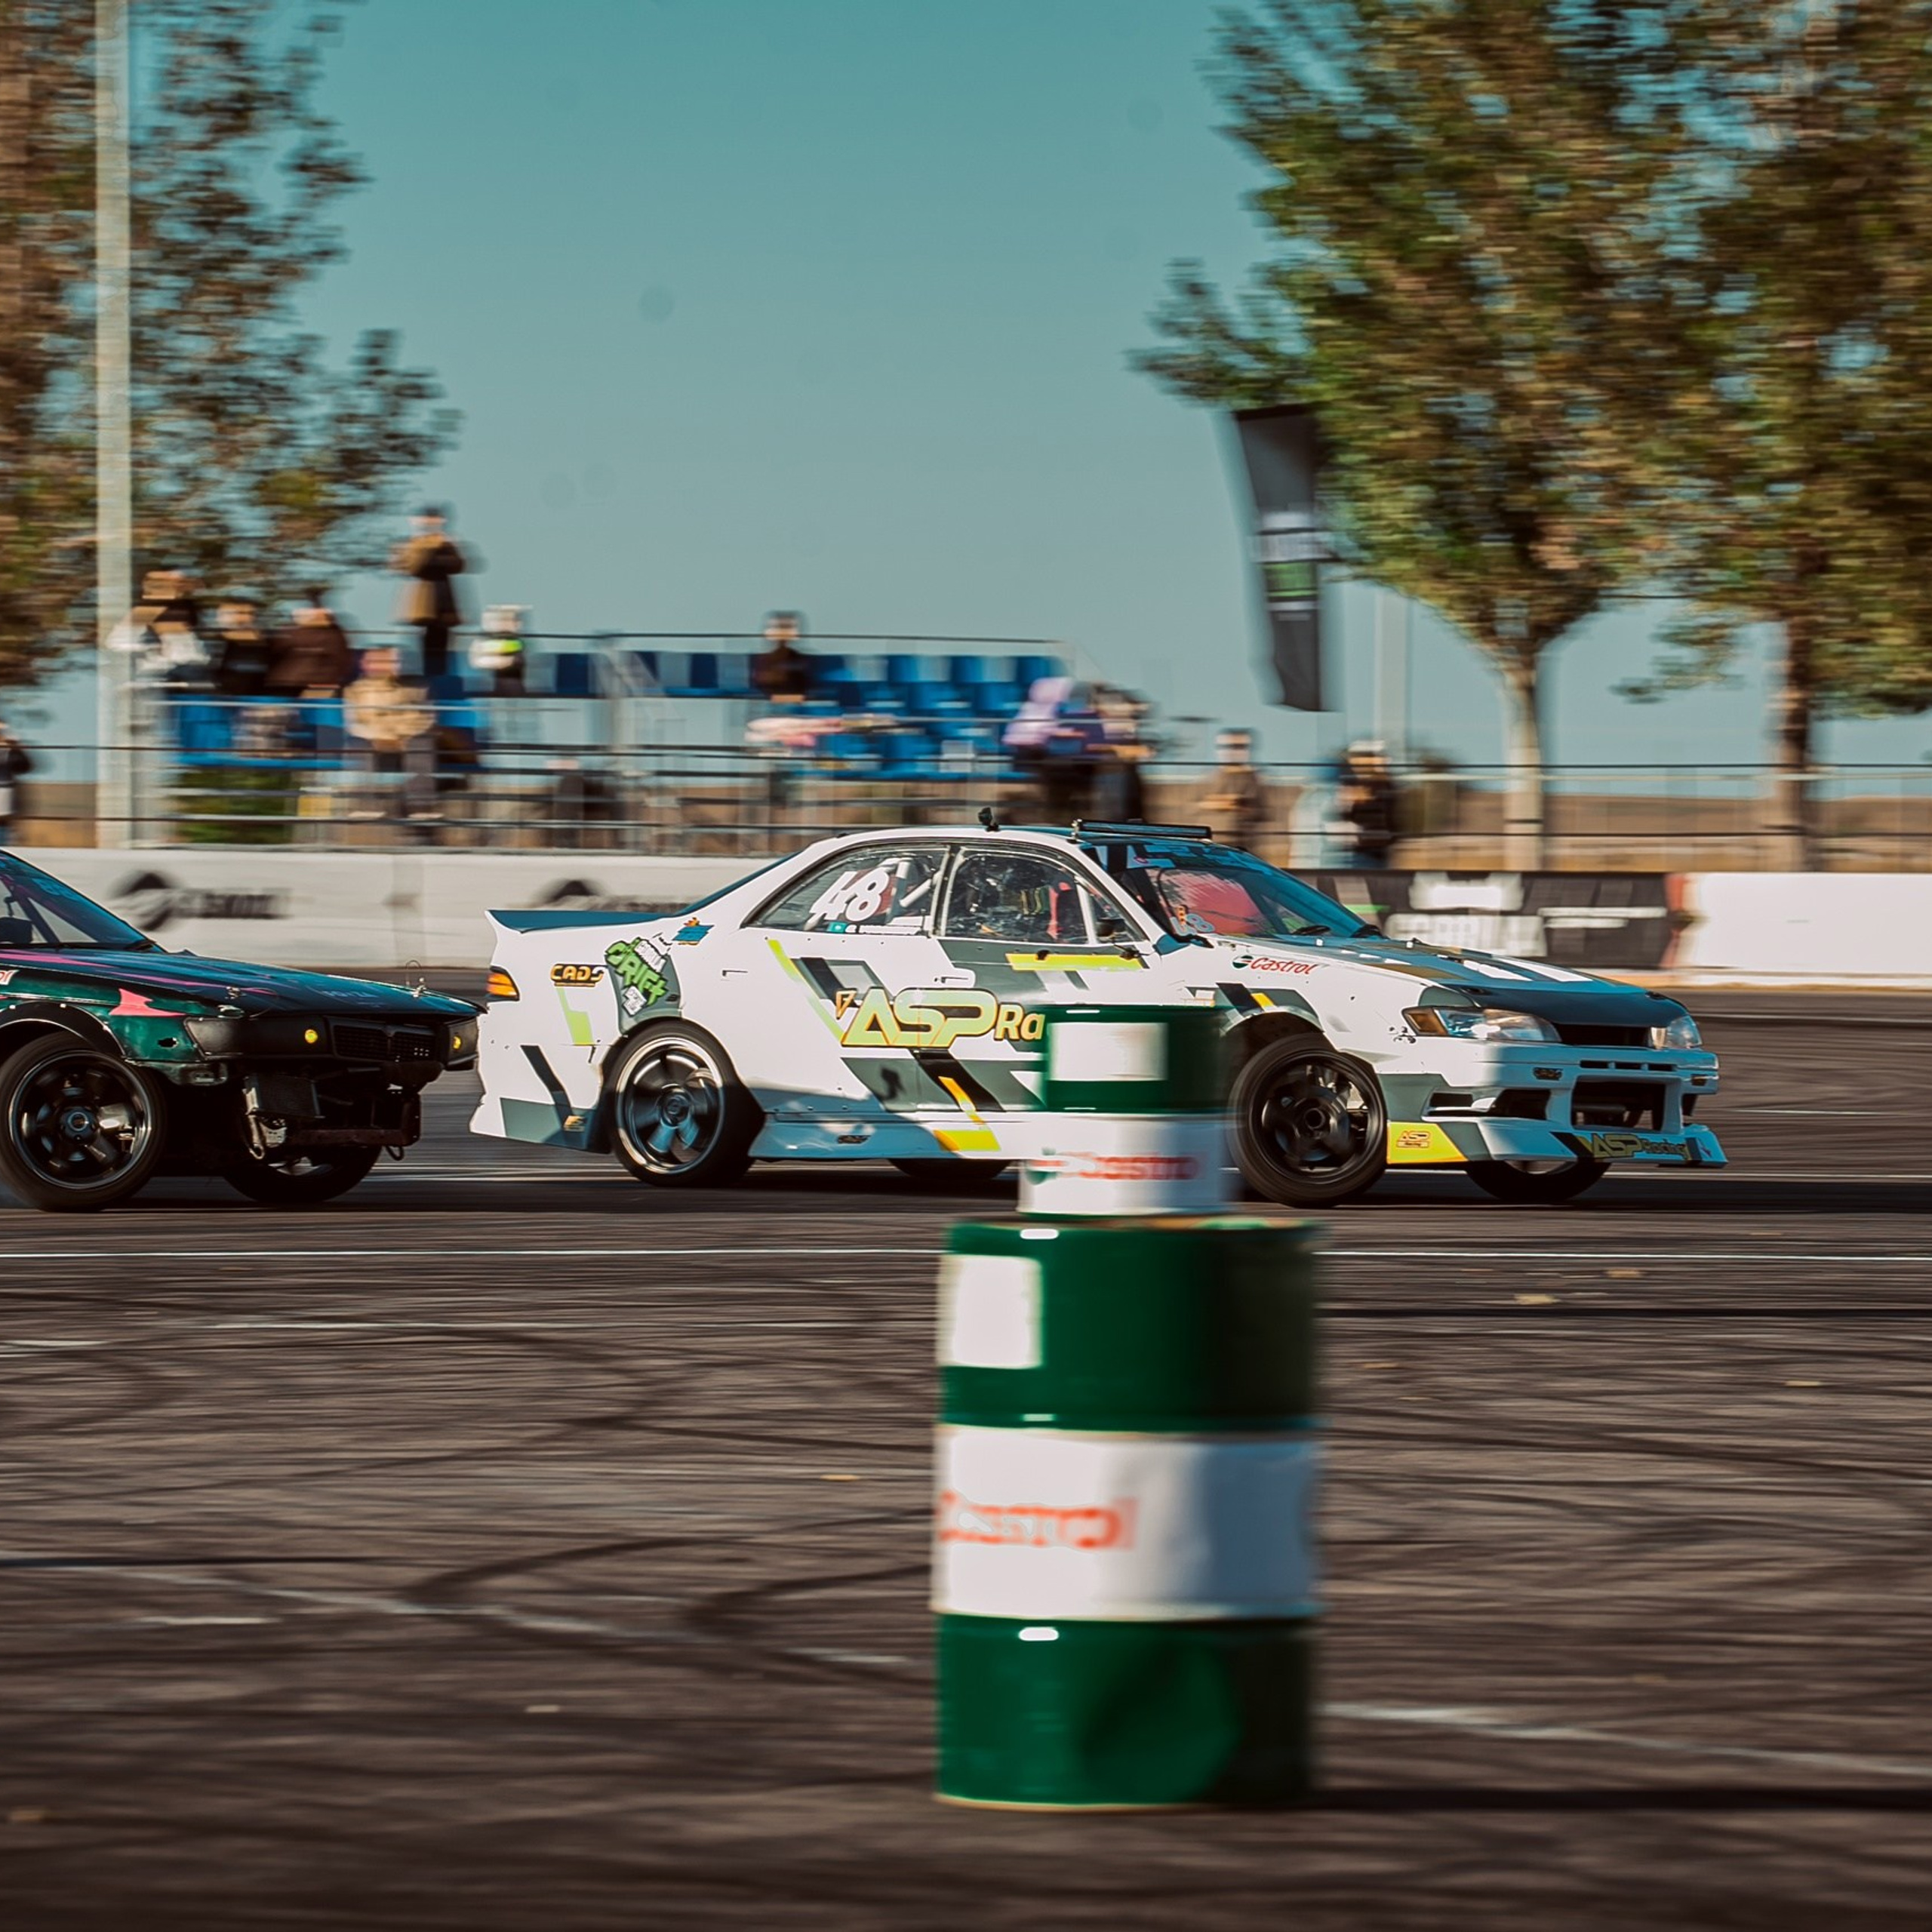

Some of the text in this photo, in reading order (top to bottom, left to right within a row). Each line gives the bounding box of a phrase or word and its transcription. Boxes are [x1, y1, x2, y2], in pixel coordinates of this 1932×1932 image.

[809, 867, 889, 922] 48
[1250, 957, 1318, 975] Castrol
[841, 986, 998, 1048] ASP
[1592, 1134, 1642, 1158] ASP
